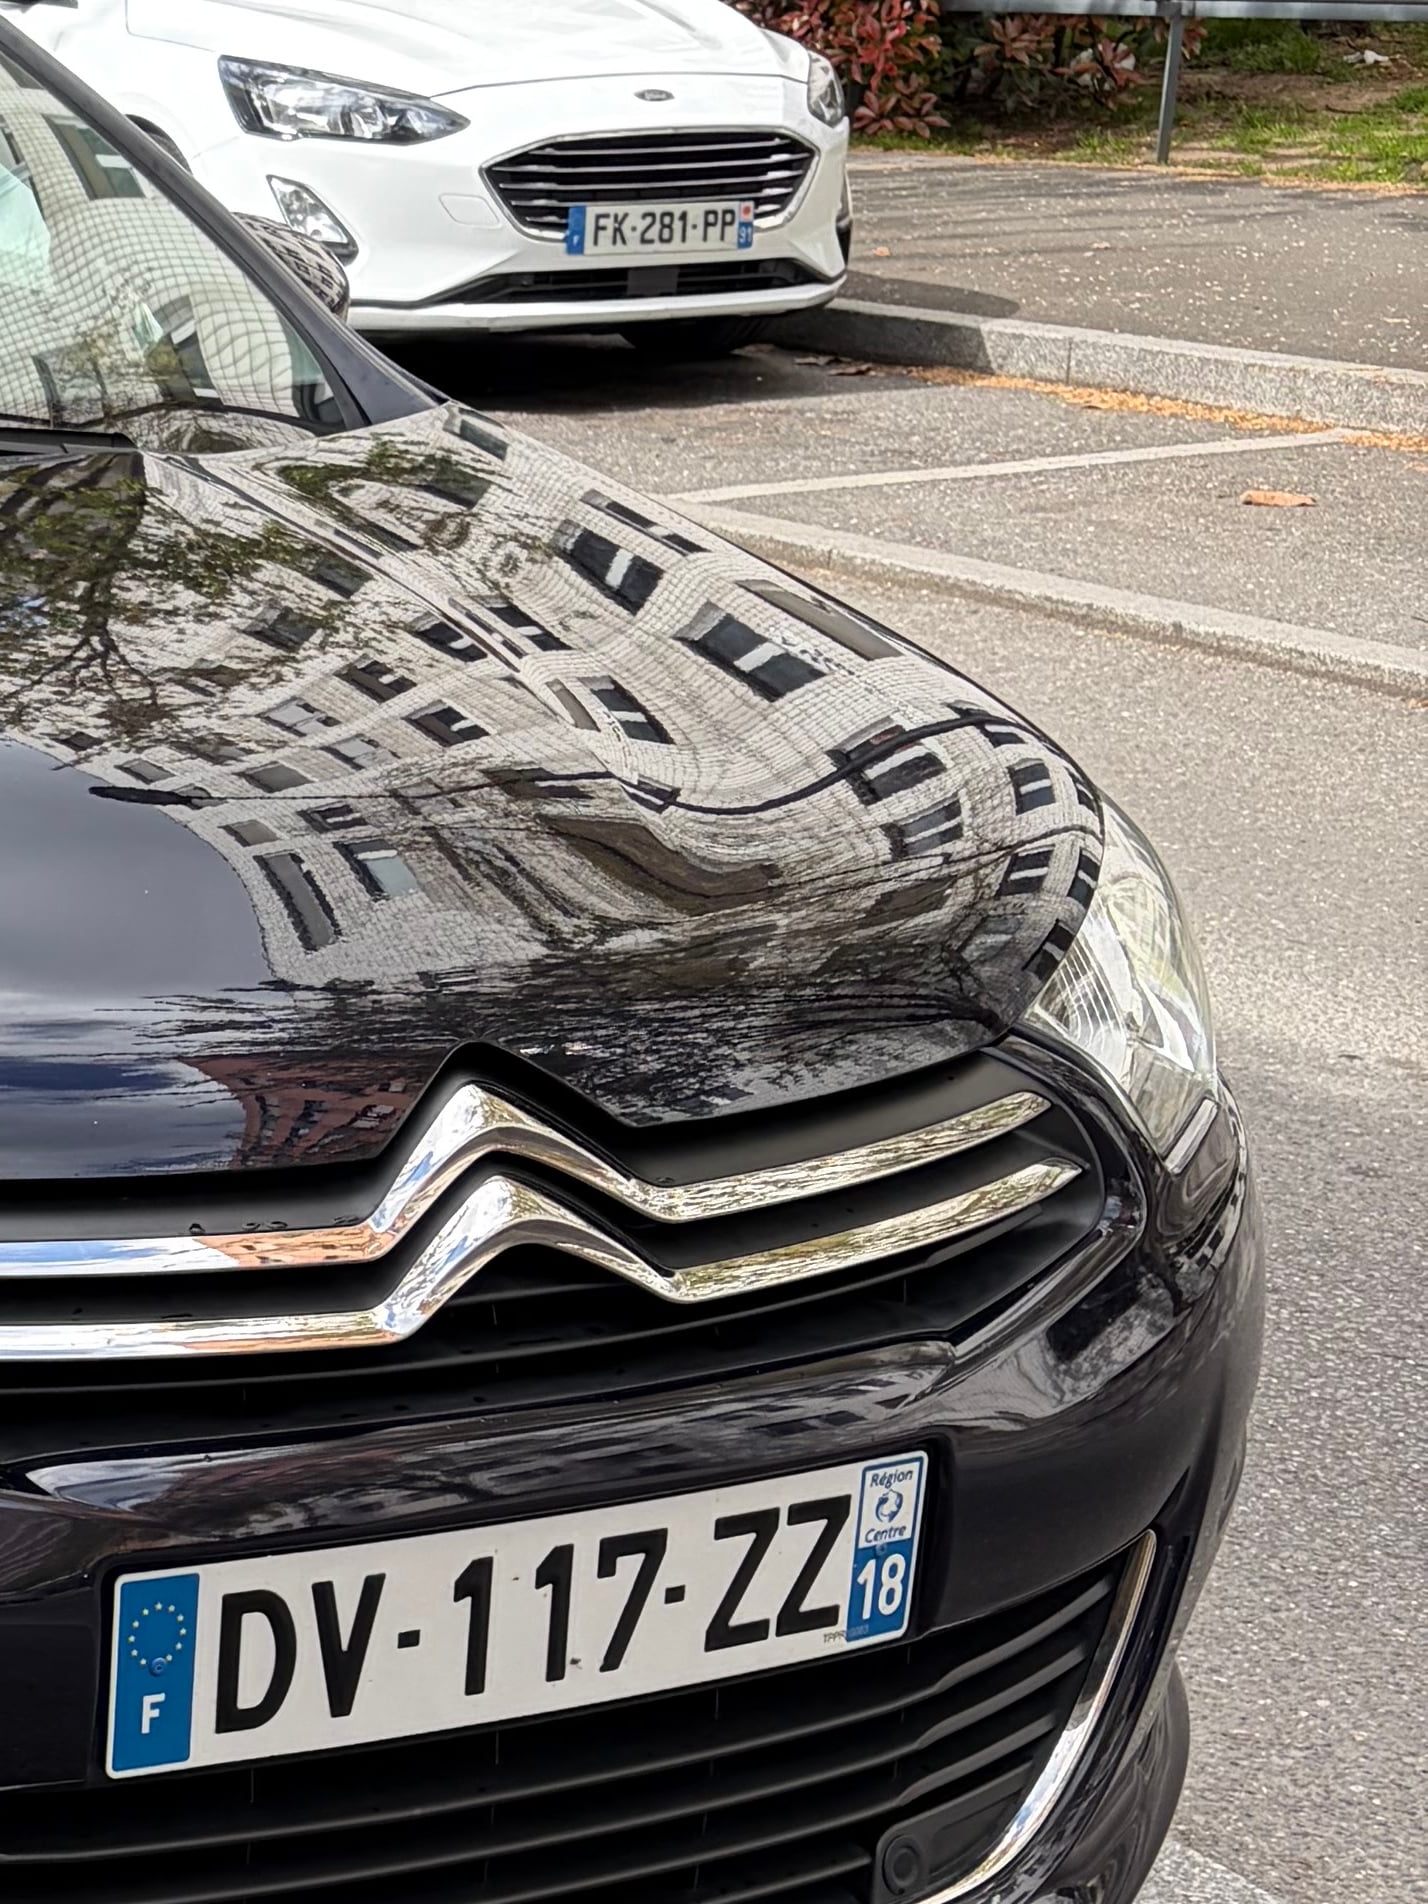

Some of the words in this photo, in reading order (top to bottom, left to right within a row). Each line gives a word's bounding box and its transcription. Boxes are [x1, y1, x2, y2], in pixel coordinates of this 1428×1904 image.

[593, 208, 736, 246] FK-281-PP
[870, 1468, 914, 1490] Région
[865, 1525, 907, 1544] Centre
[857, 1553, 907, 1620] 18
[141, 1692, 166, 1735] F
[215, 1494, 853, 1734] DV-117-ZZ
